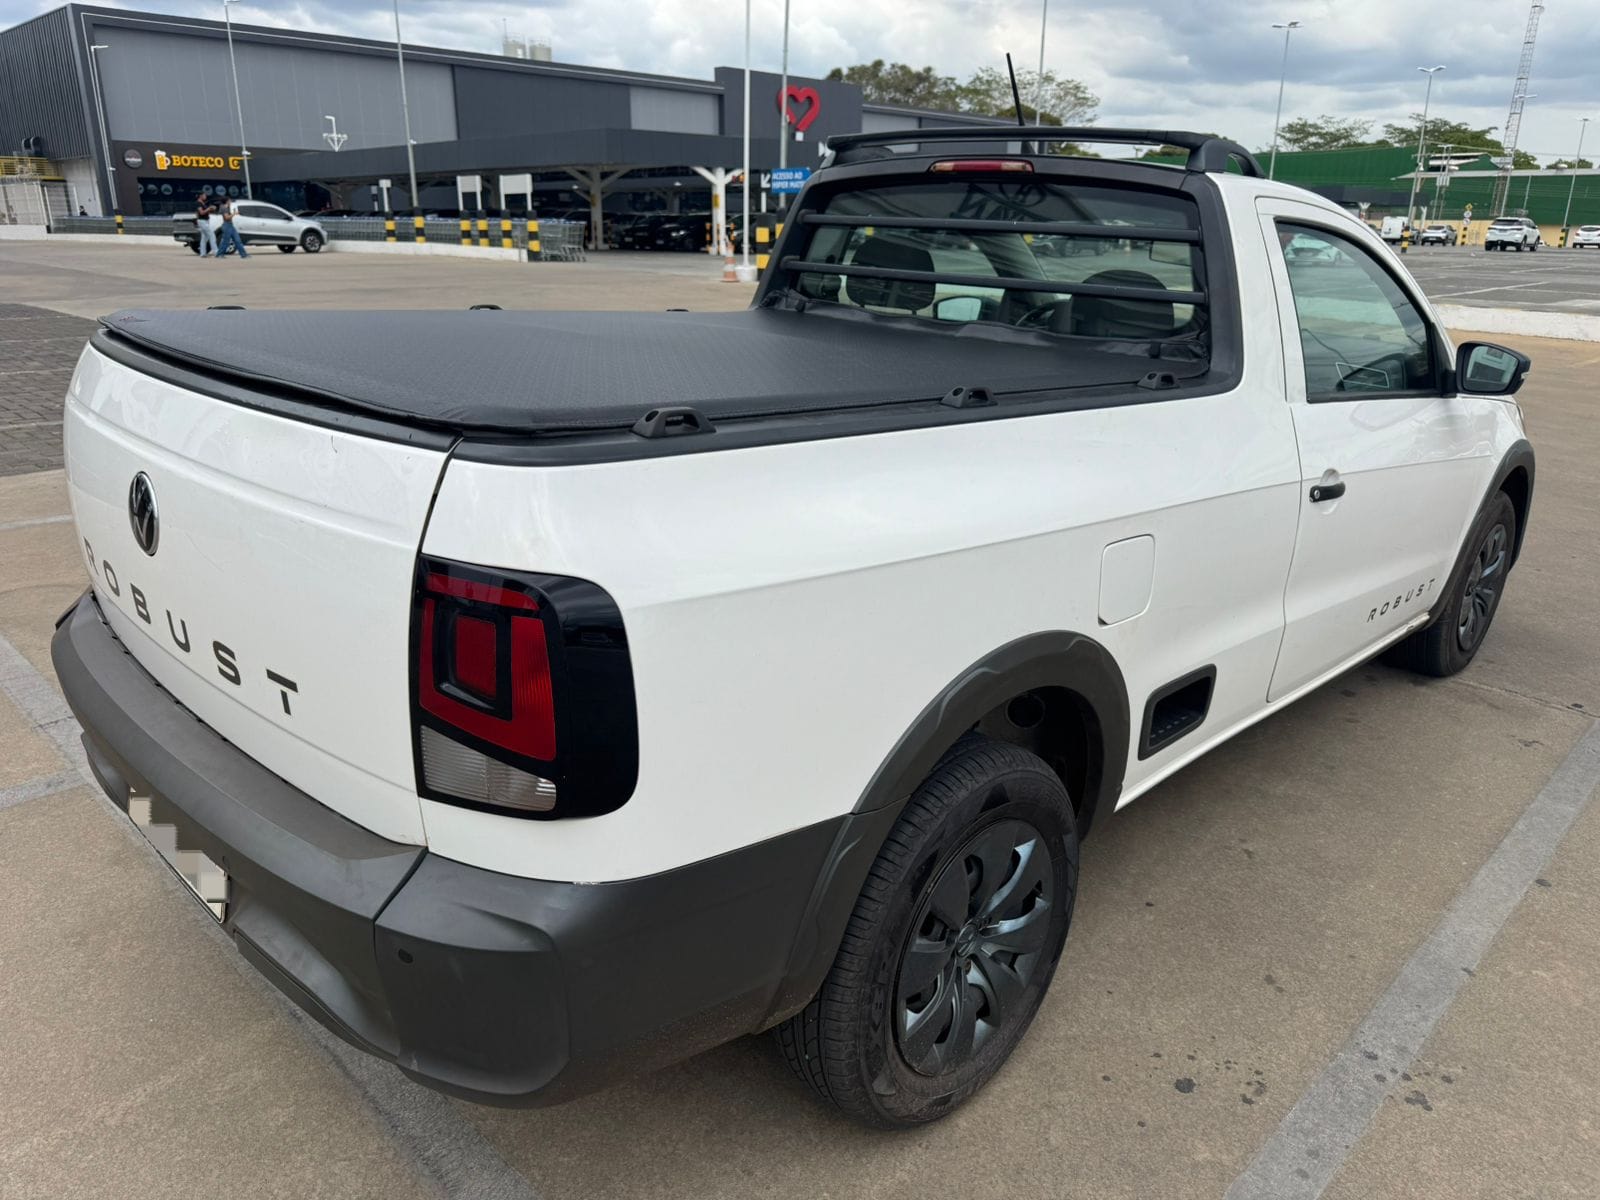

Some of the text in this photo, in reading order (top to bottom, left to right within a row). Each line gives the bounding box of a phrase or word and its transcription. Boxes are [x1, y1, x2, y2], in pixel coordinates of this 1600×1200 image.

[171, 155, 224, 168] BOTECO
[1366, 578, 1435, 623] ROBUST
[84, 536, 298, 716] ROBUST
